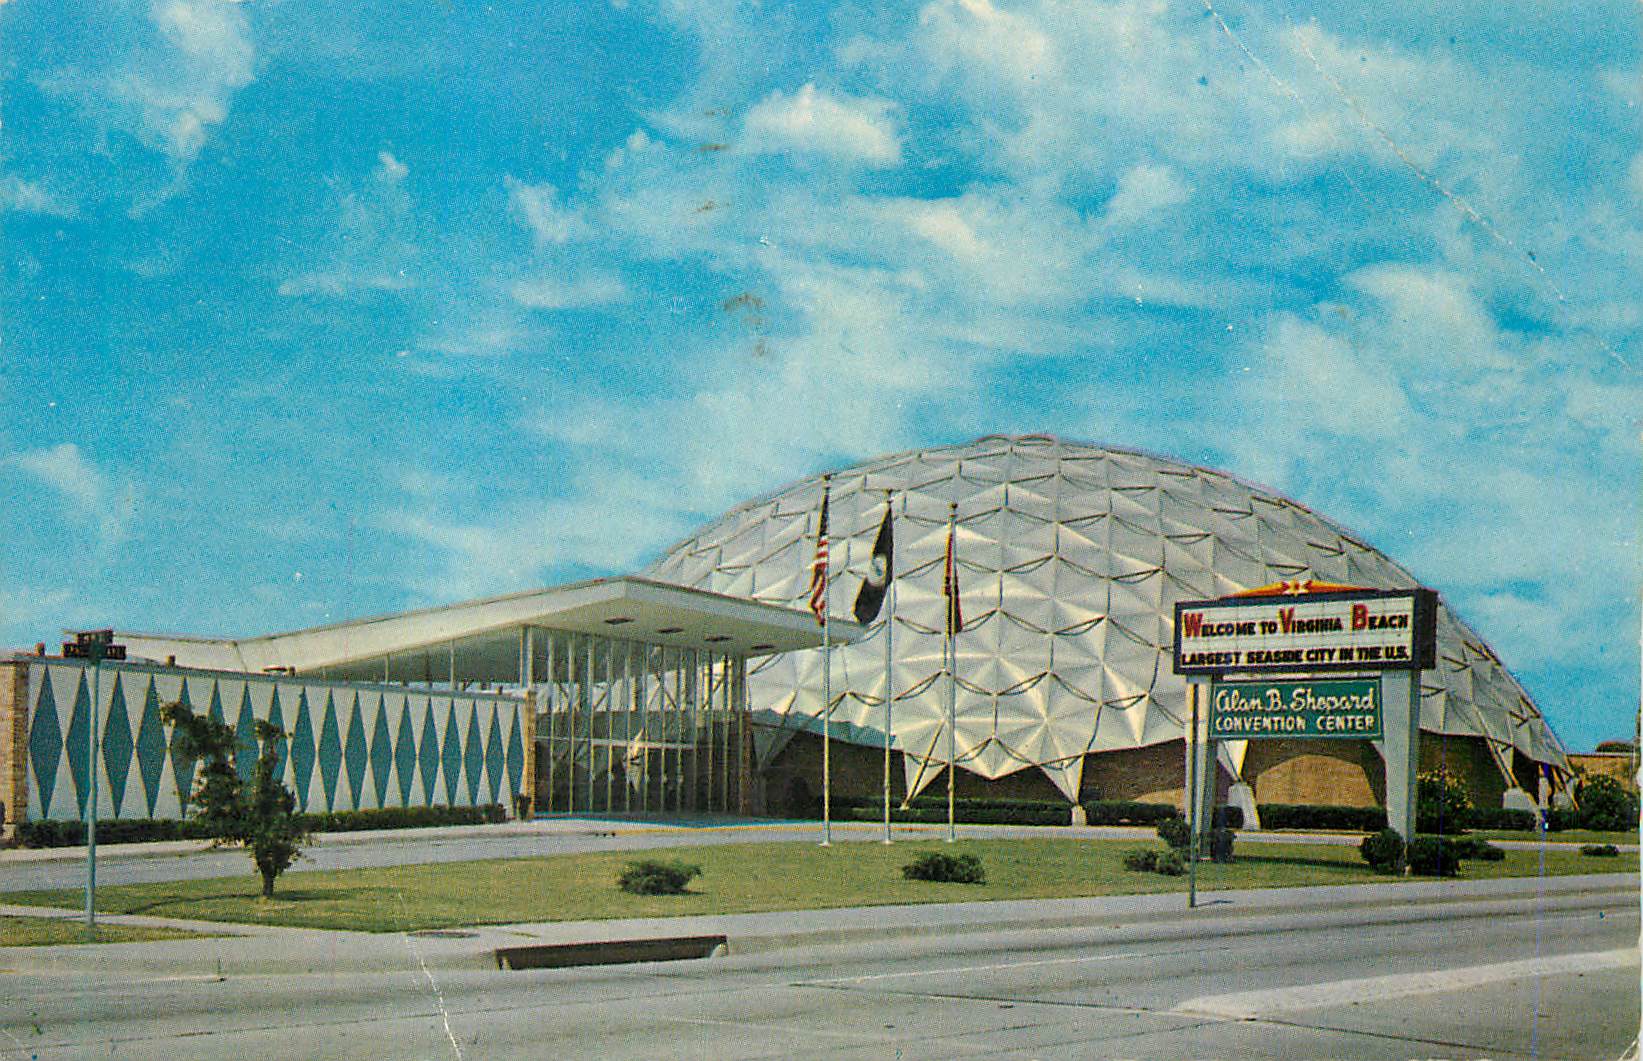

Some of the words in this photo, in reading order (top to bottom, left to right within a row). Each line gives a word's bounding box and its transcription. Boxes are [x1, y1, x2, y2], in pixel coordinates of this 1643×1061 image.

[1183, 612, 1256, 638] WELCOME
[1261, 620, 1277, 634] TO
[1279, 607, 1343, 633] VIRGINIA
[1352, 604, 1409, 630] BEACH
[1182, 651, 1241, 666] LARGEST
[1246, 649, 1303, 664] SEASIDE
[1306, 648, 1337, 662] CITY
[1340, 647, 1354, 661] IN
[1358, 646, 1382, 660] THE
[1215, 688, 1264, 712] Alan
[1266, 688, 1287, 711] B.
[1290, 687, 1375, 712] Shepard
[1215, 715, 1306, 732] CONVENTION
[1316, 715, 1375, 731] CENTER
